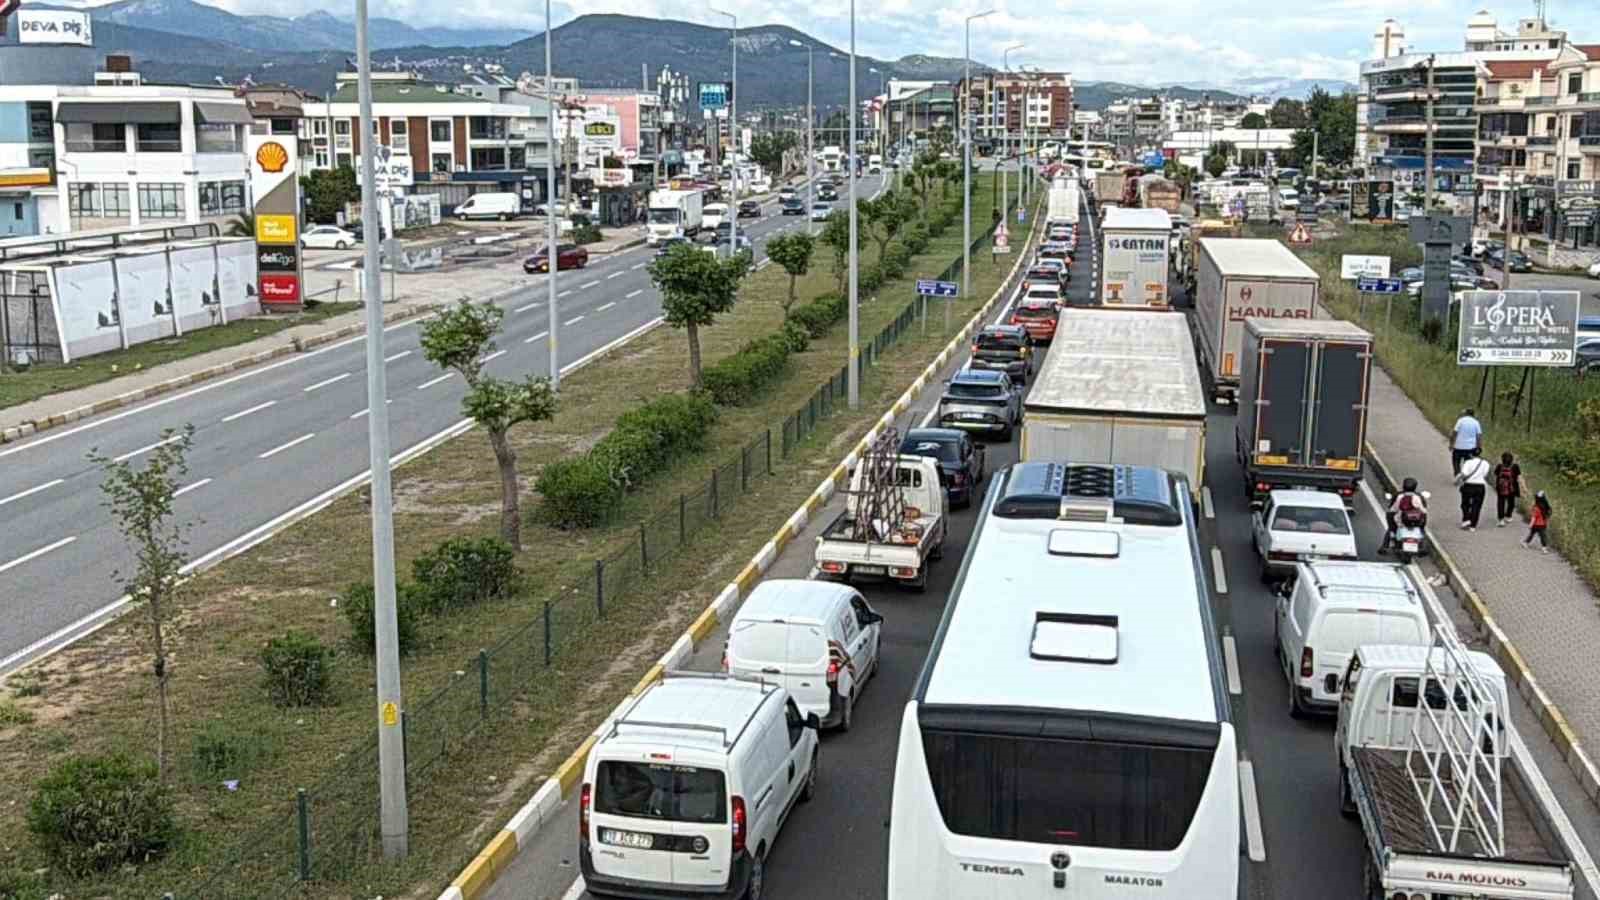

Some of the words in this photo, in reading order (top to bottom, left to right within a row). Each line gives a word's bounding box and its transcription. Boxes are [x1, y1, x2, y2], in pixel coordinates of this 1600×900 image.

[21, 21, 57, 31] DEVA
[1229, 306, 1308, 319] HANLAR
[960, 862, 1024, 876] TEMSA
[1104, 875, 1163, 887] MARATON
[1426, 871, 1453, 880] KIA
[1458, 873, 1527, 887] MOTORS
